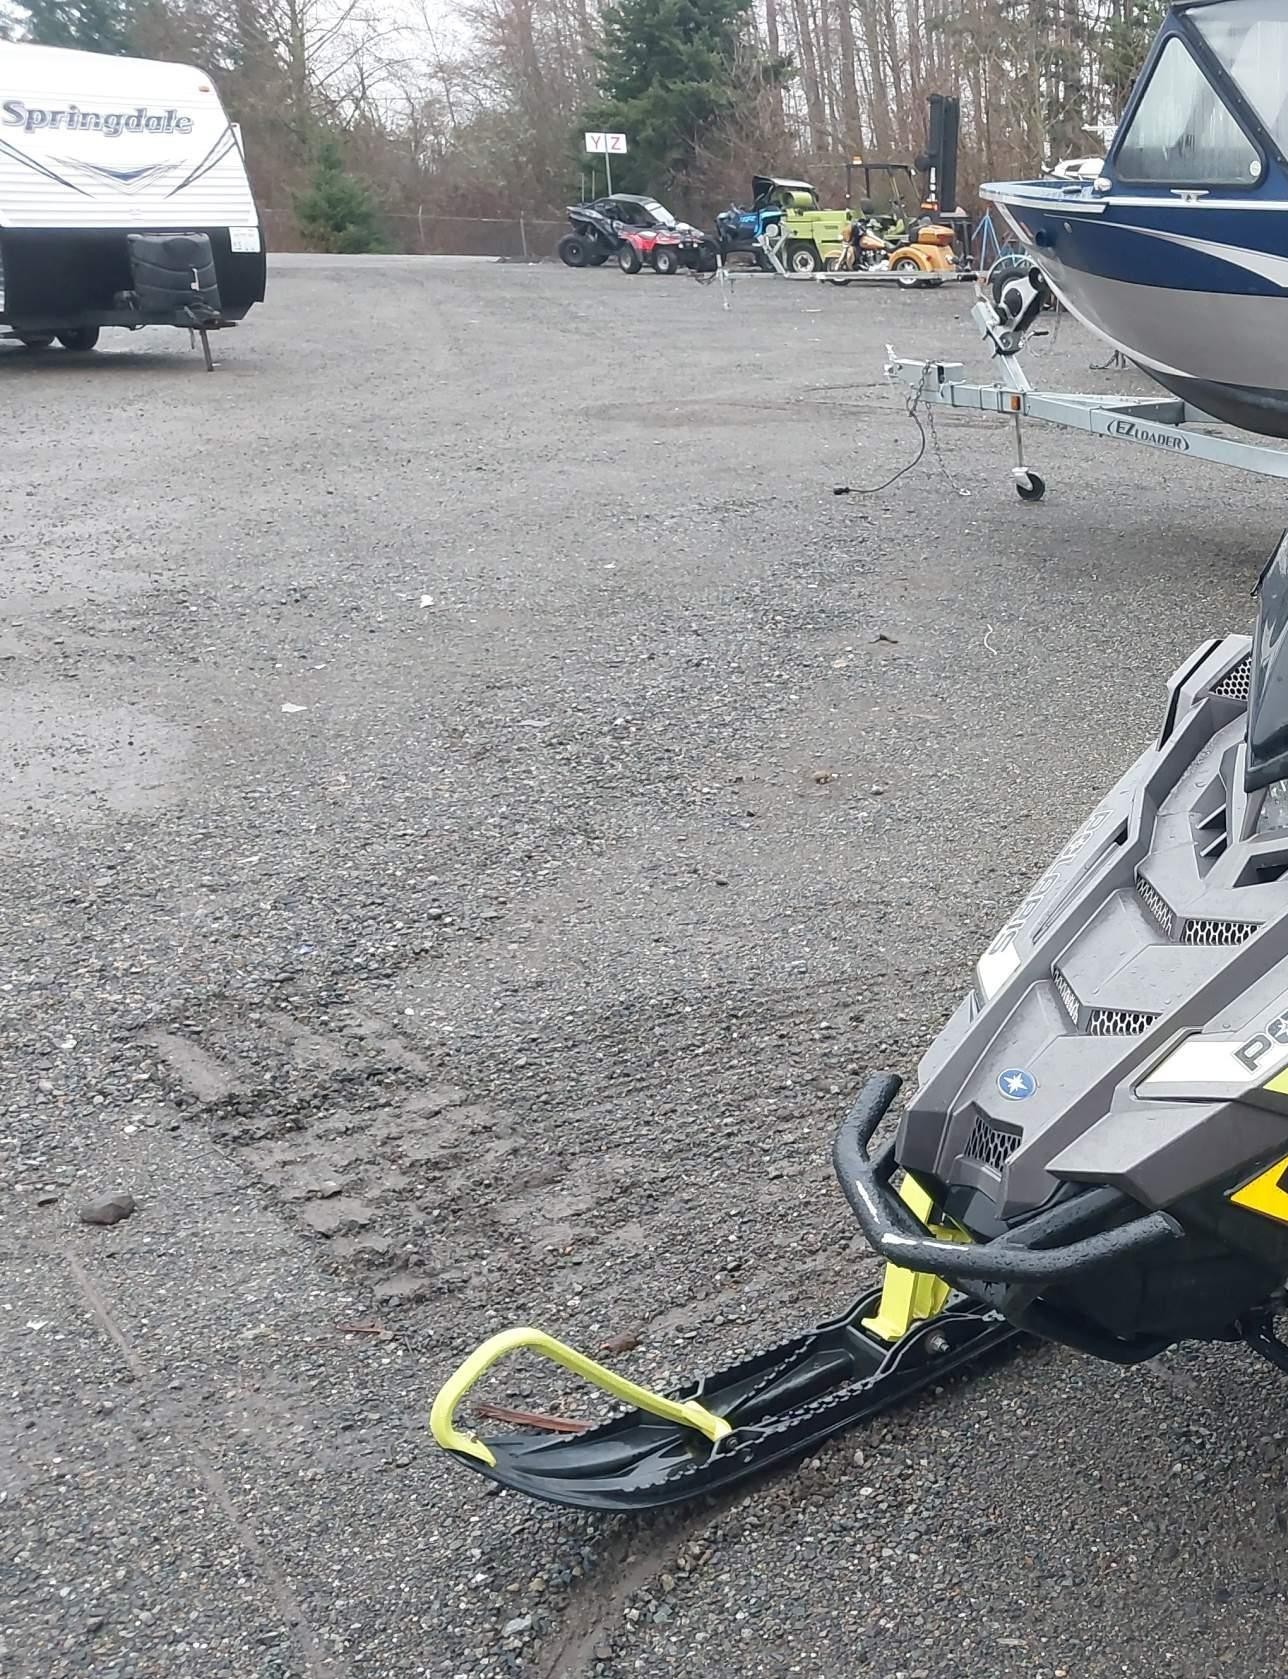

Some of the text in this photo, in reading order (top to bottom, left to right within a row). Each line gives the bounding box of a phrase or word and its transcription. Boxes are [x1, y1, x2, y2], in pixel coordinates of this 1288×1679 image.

[2, 99, 194, 137] Springdale
[590, 135, 622, 151] Y Z
